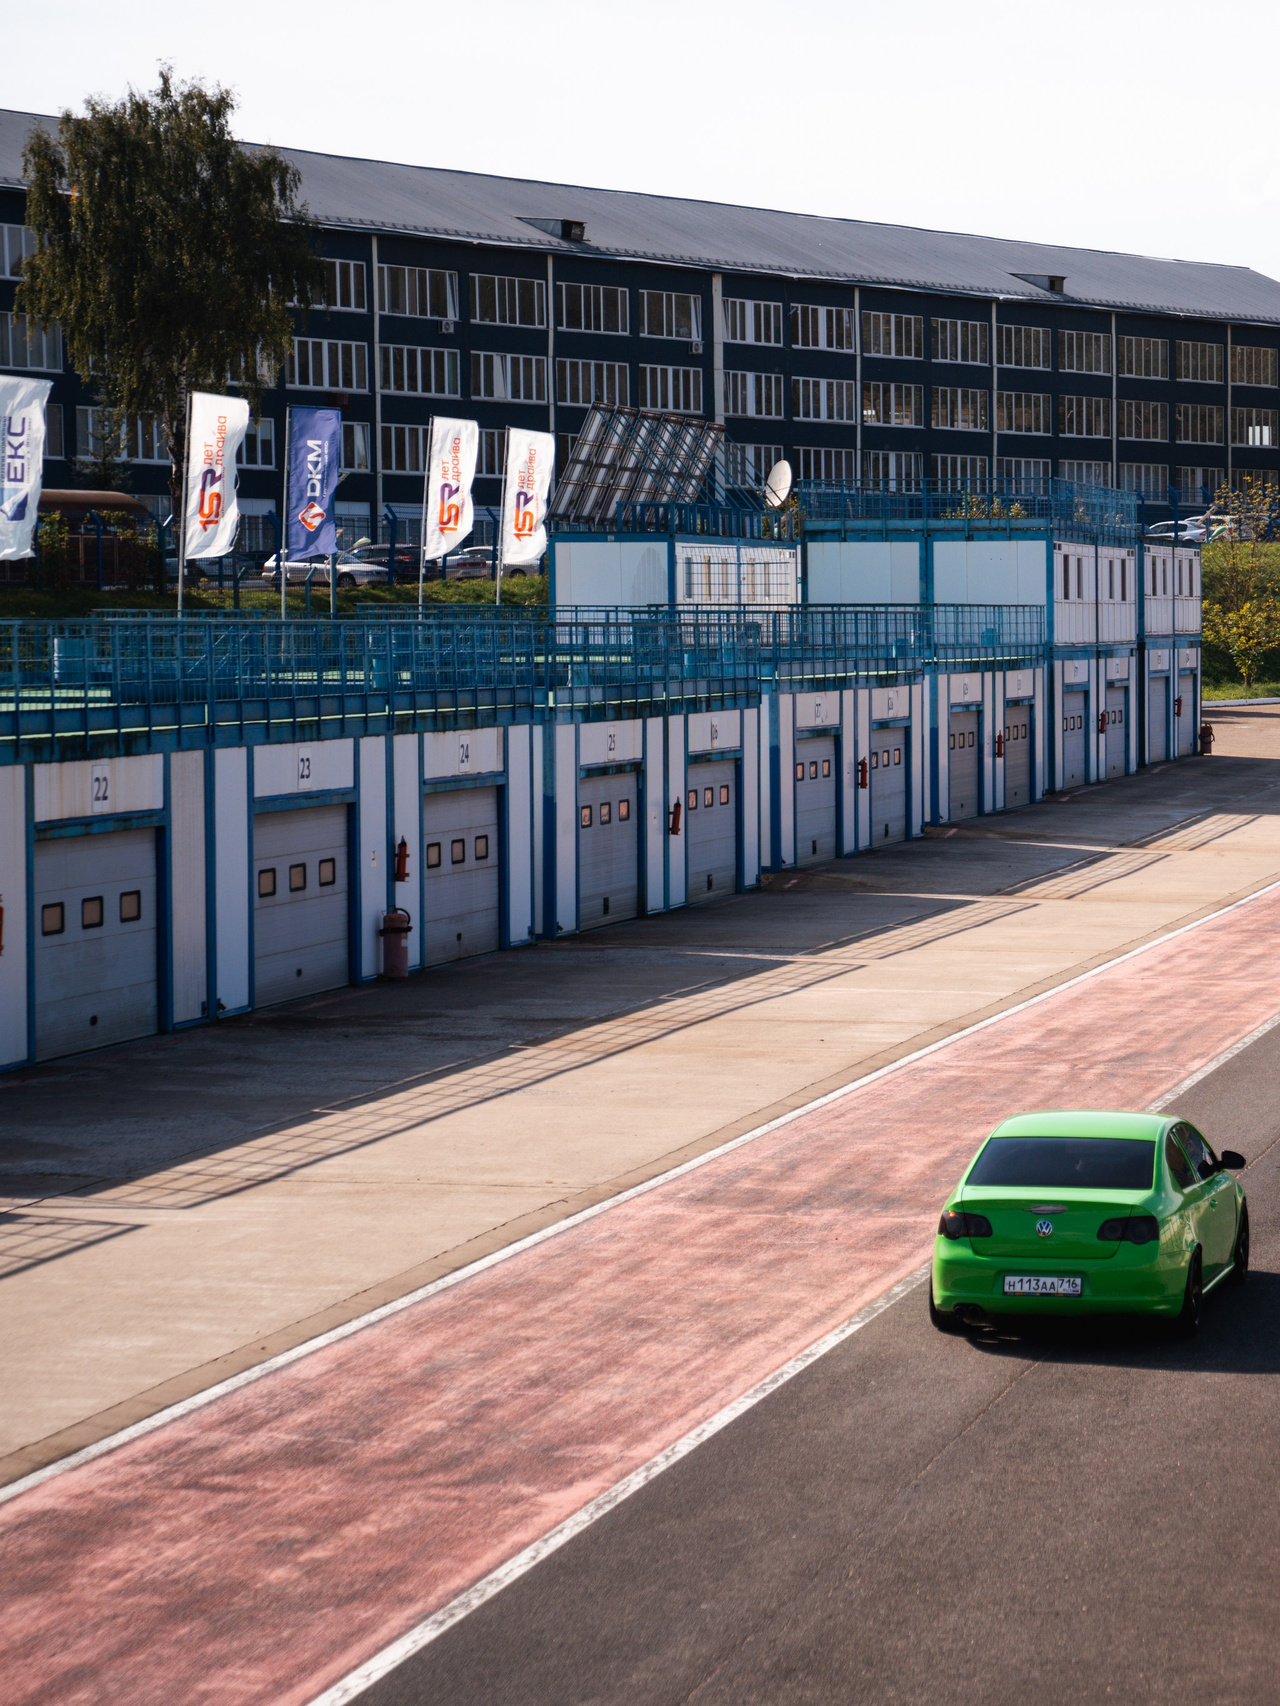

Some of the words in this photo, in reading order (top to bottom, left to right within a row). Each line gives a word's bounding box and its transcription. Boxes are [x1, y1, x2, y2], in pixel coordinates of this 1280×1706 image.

[202, 441, 214, 466] лет
[448, 438, 462, 482] драйва
[306, 440, 322, 497] DKM
[441, 460, 449, 480] лет
[517, 469, 526, 490] лет
[524, 448, 536, 490] драйва
[460, 744, 470, 764] 24
[608, 734, 616, 751] 25
[299, 758, 311, 778] 23
[94, 776, 108, 802] 22
